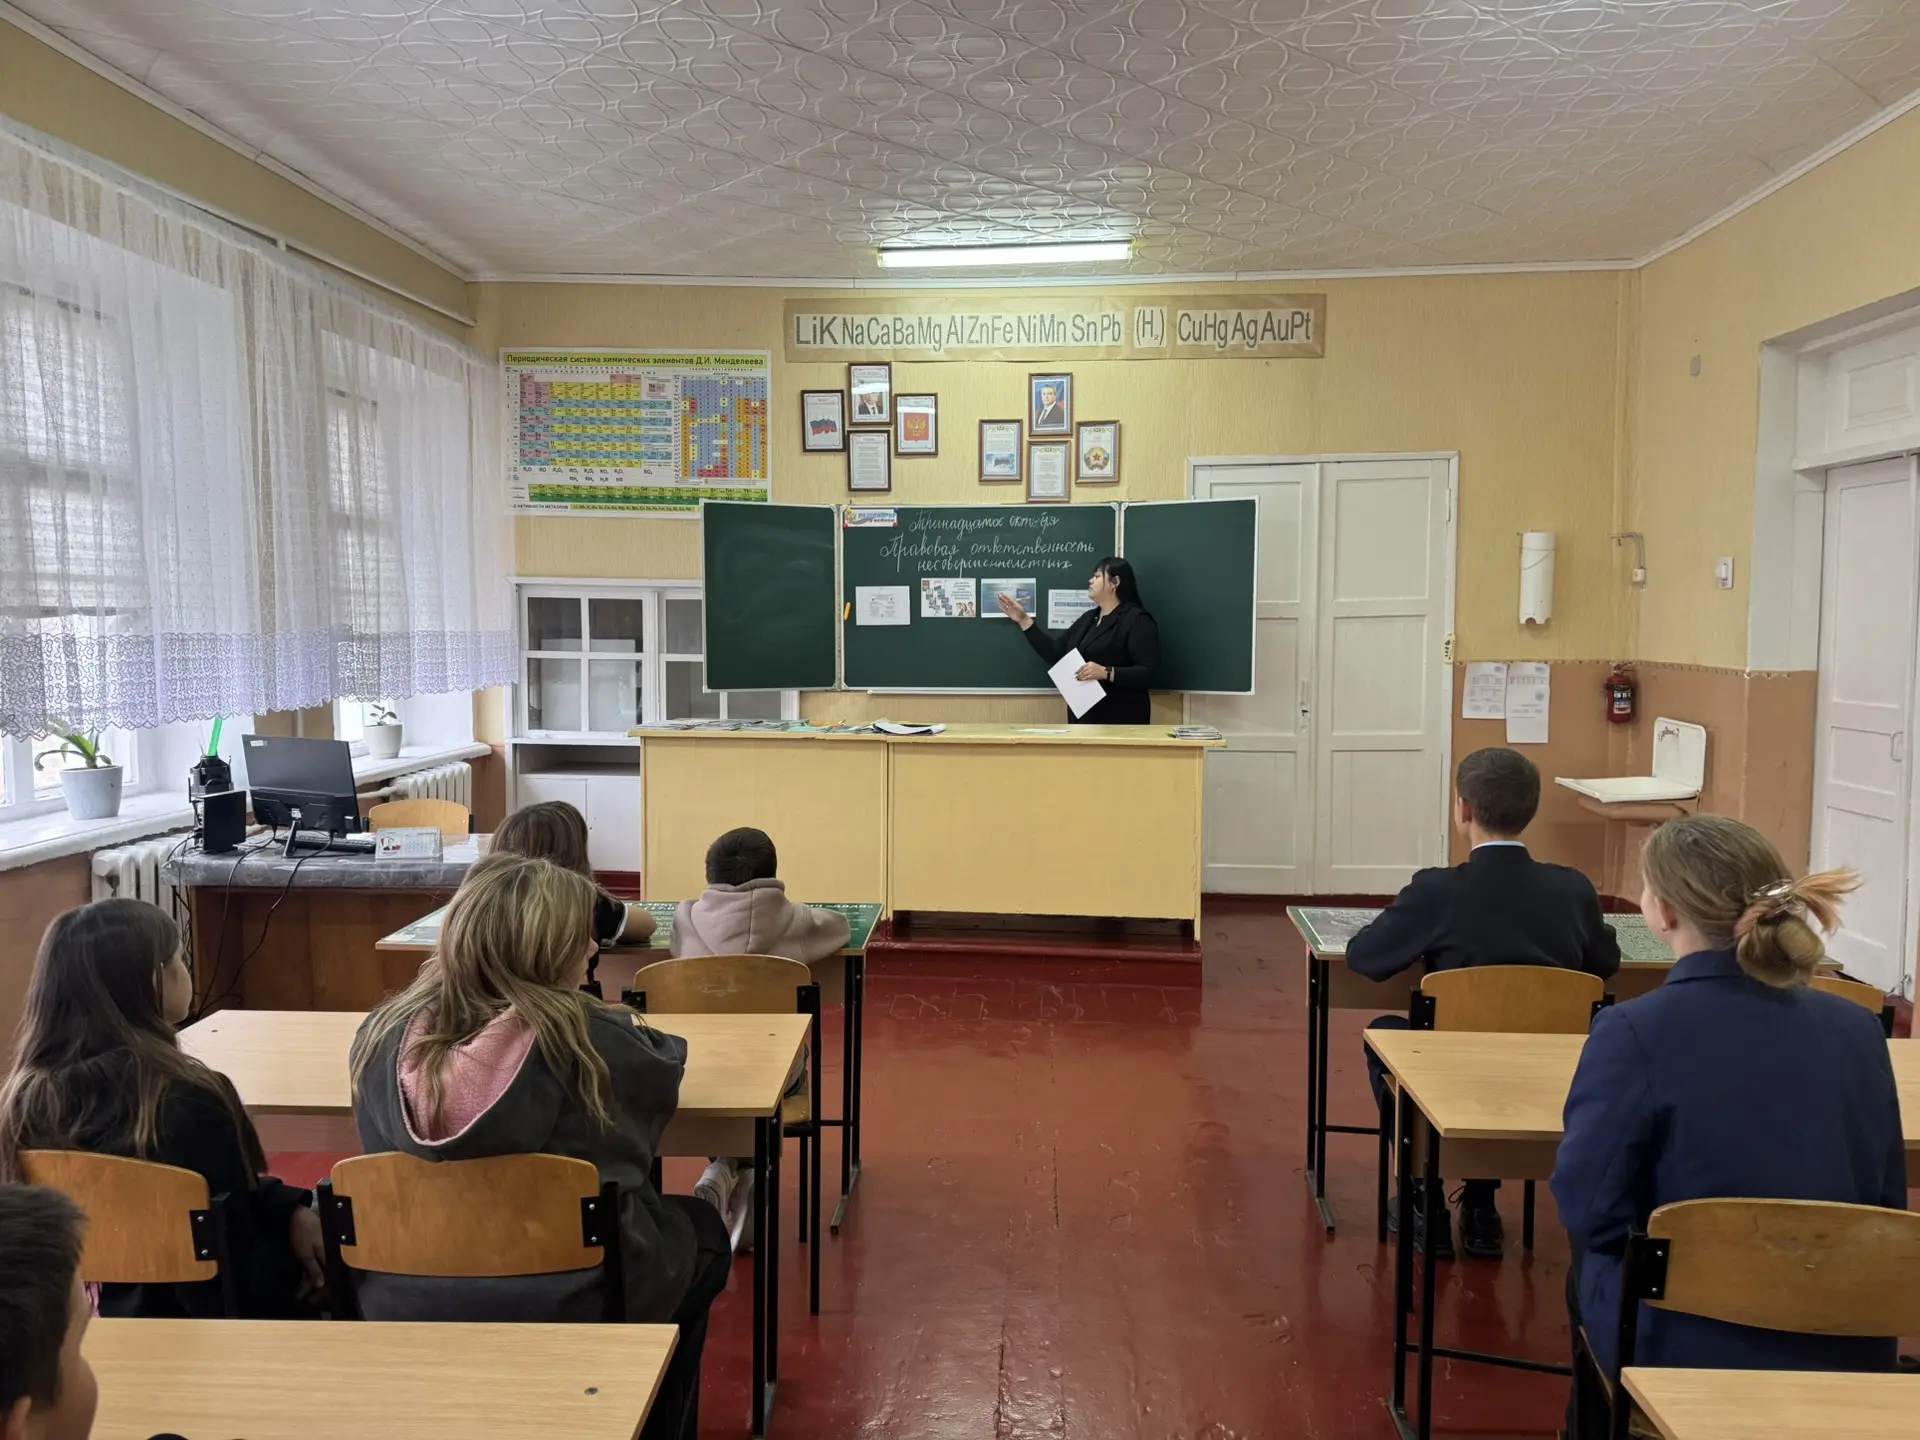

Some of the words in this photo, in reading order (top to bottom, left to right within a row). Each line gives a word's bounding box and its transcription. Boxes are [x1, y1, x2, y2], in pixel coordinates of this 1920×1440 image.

[507, 353, 568, 365] Периодическая
[570, 355, 600, 364] система
[603, 356, 650, 365] химических
[652, 357, 694, 365] элементов
[714, 357, 763, 366] Менделеева
[880, 533, 960, 572] Правовая
[971, 535, 1095, 555] ответственность
